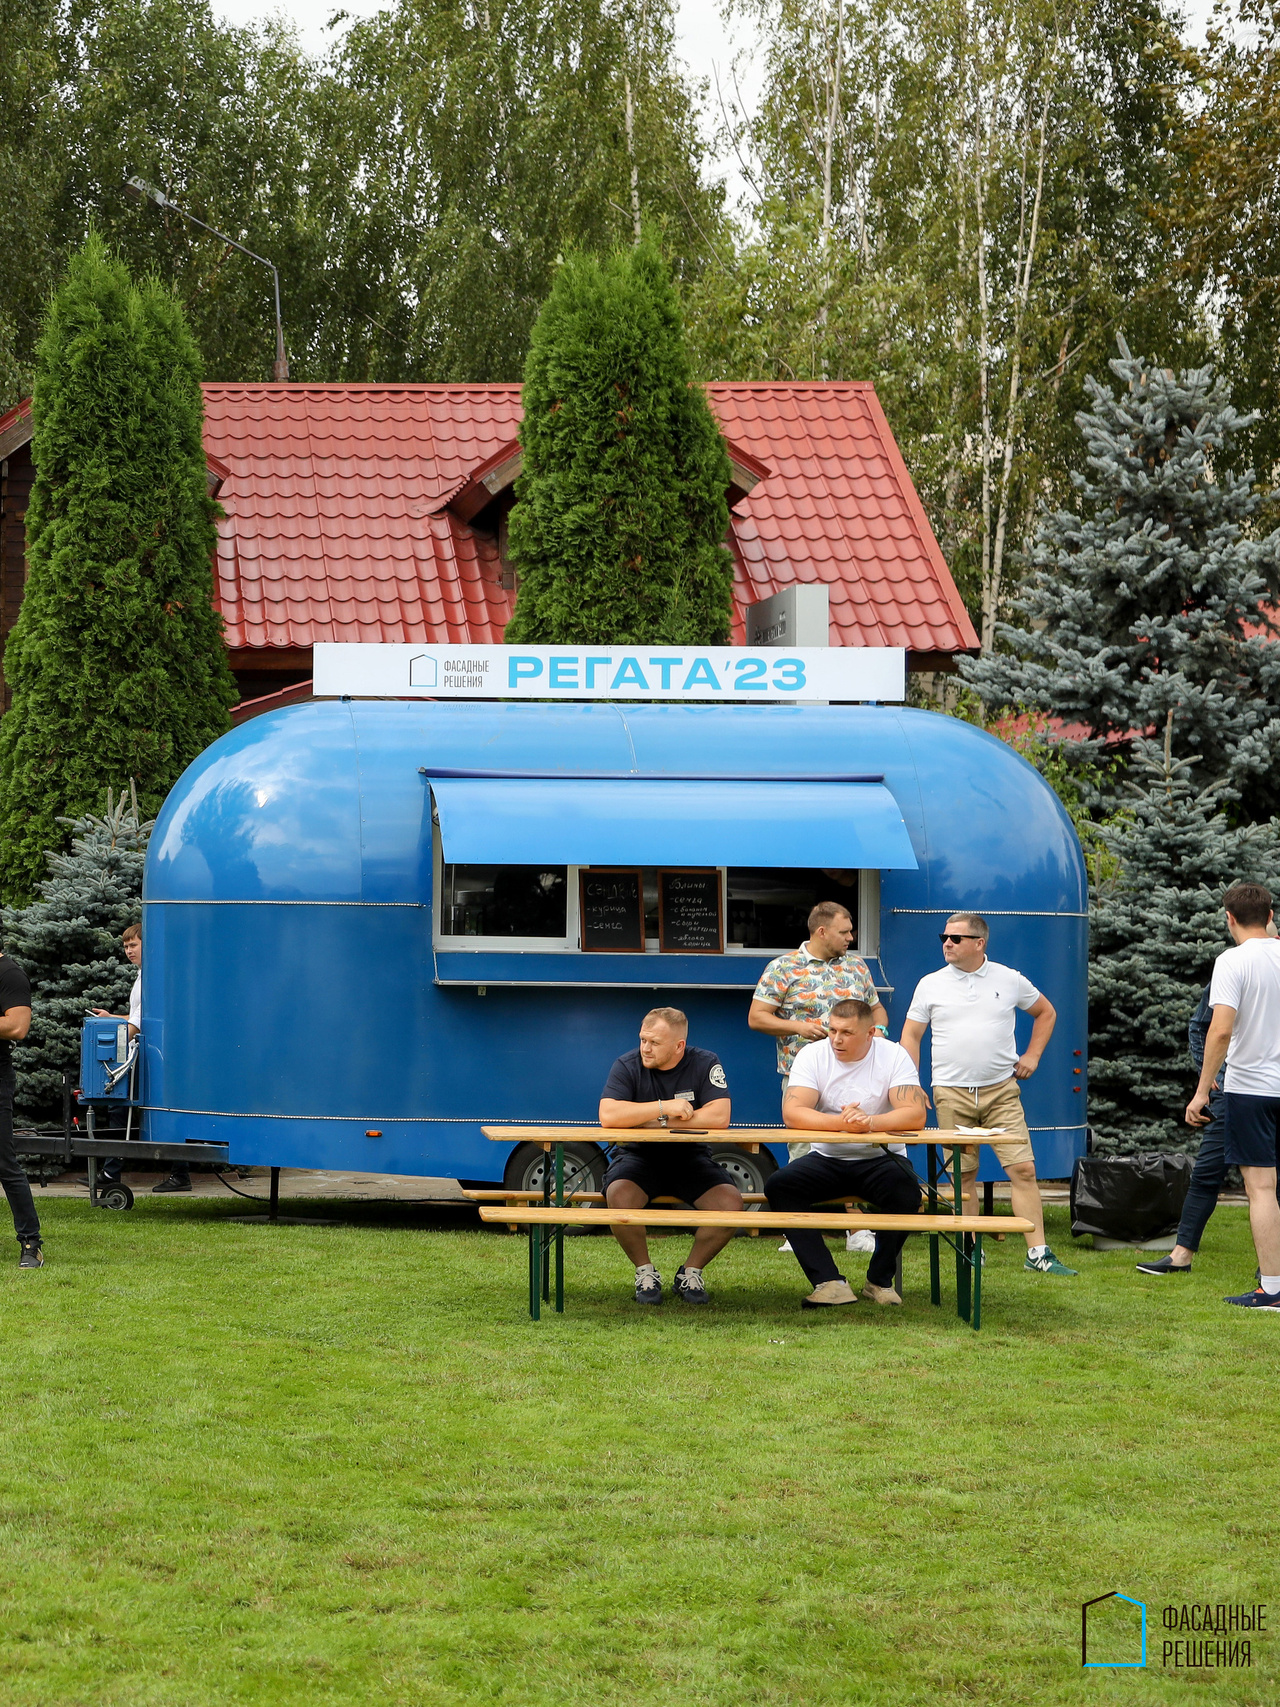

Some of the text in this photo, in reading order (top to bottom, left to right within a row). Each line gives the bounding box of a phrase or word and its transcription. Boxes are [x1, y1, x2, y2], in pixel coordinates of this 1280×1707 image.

[443, 660, 490, 673] ФАСАДНЫЕ
[508, 656, 807, 692] РЕГАТА'23
[443, 675, 483, 688] РЕШЕНИЯ
